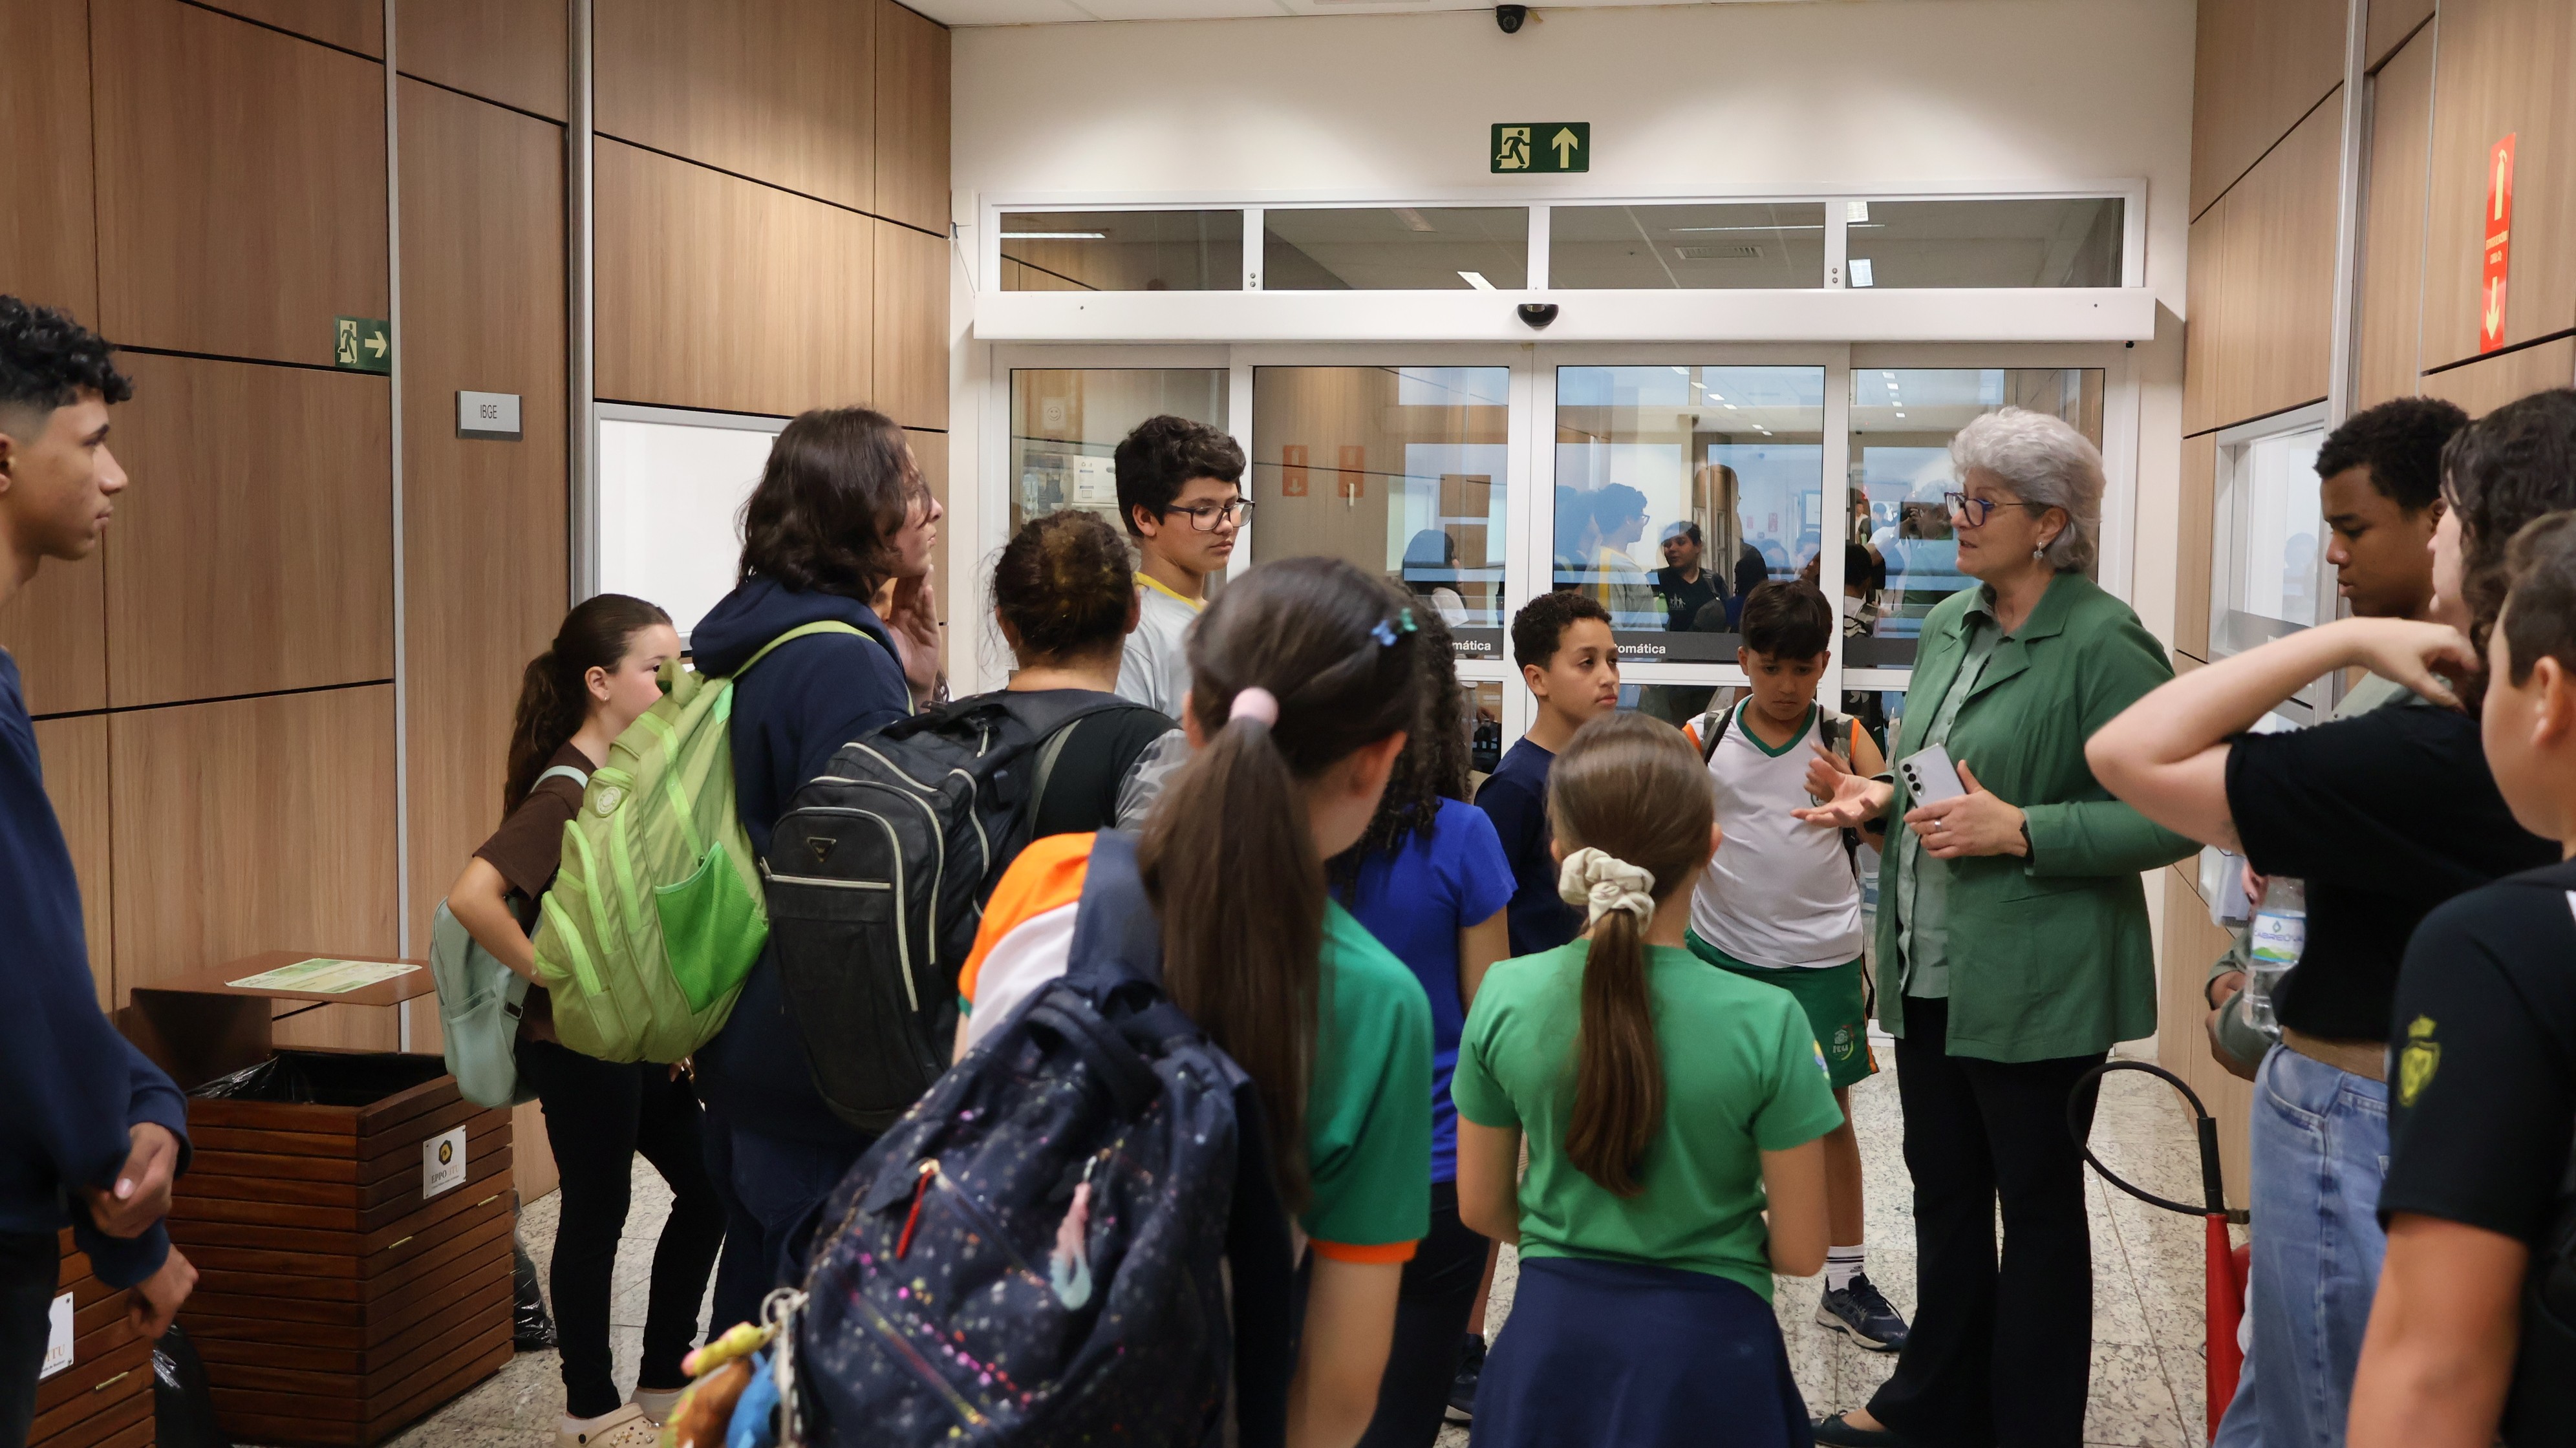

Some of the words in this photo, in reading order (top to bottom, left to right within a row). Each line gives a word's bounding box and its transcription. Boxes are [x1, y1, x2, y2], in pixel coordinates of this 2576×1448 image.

[480, 404, 497, 419] IBGE
[1452, 640, 1491, 652] mática
[431, 1169, 447, 1184] EPPO
